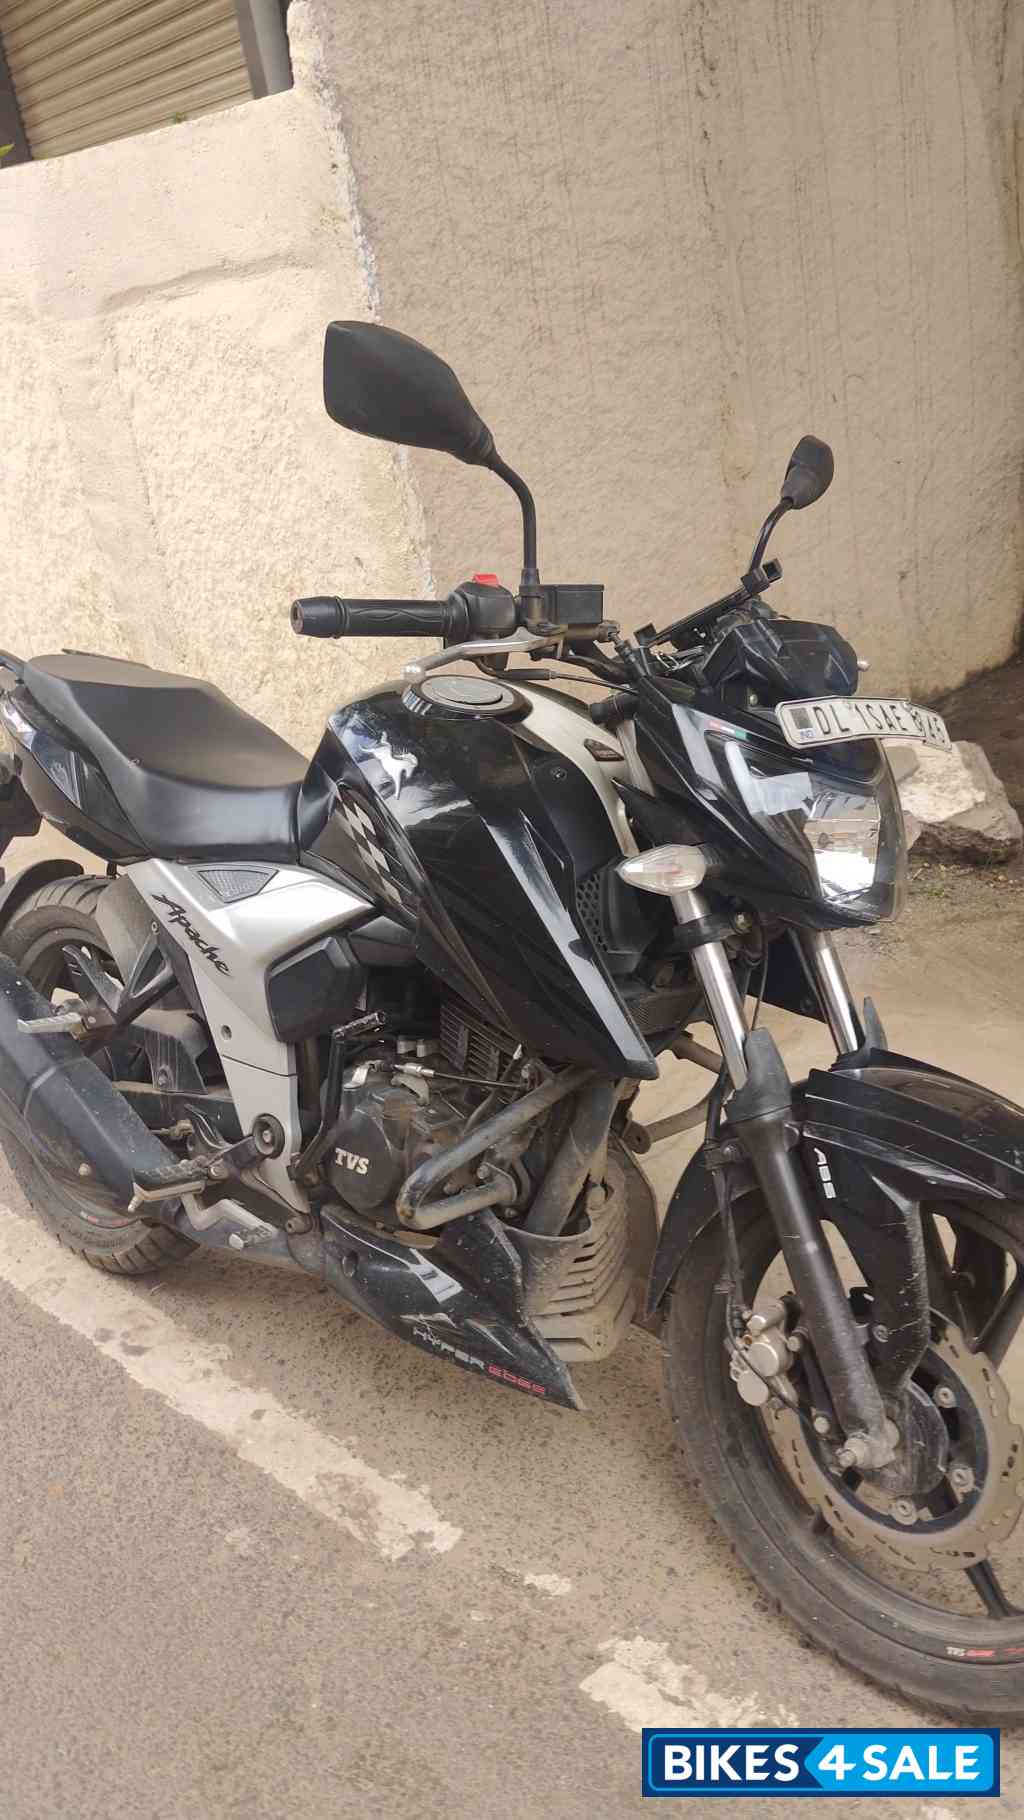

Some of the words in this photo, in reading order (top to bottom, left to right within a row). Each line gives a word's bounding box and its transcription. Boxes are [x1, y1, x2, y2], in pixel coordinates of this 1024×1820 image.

[813, 706, 850, 735] DL
[151, 894, 232, 977] Apache
[335, 1146, 370, 1175] TVS
